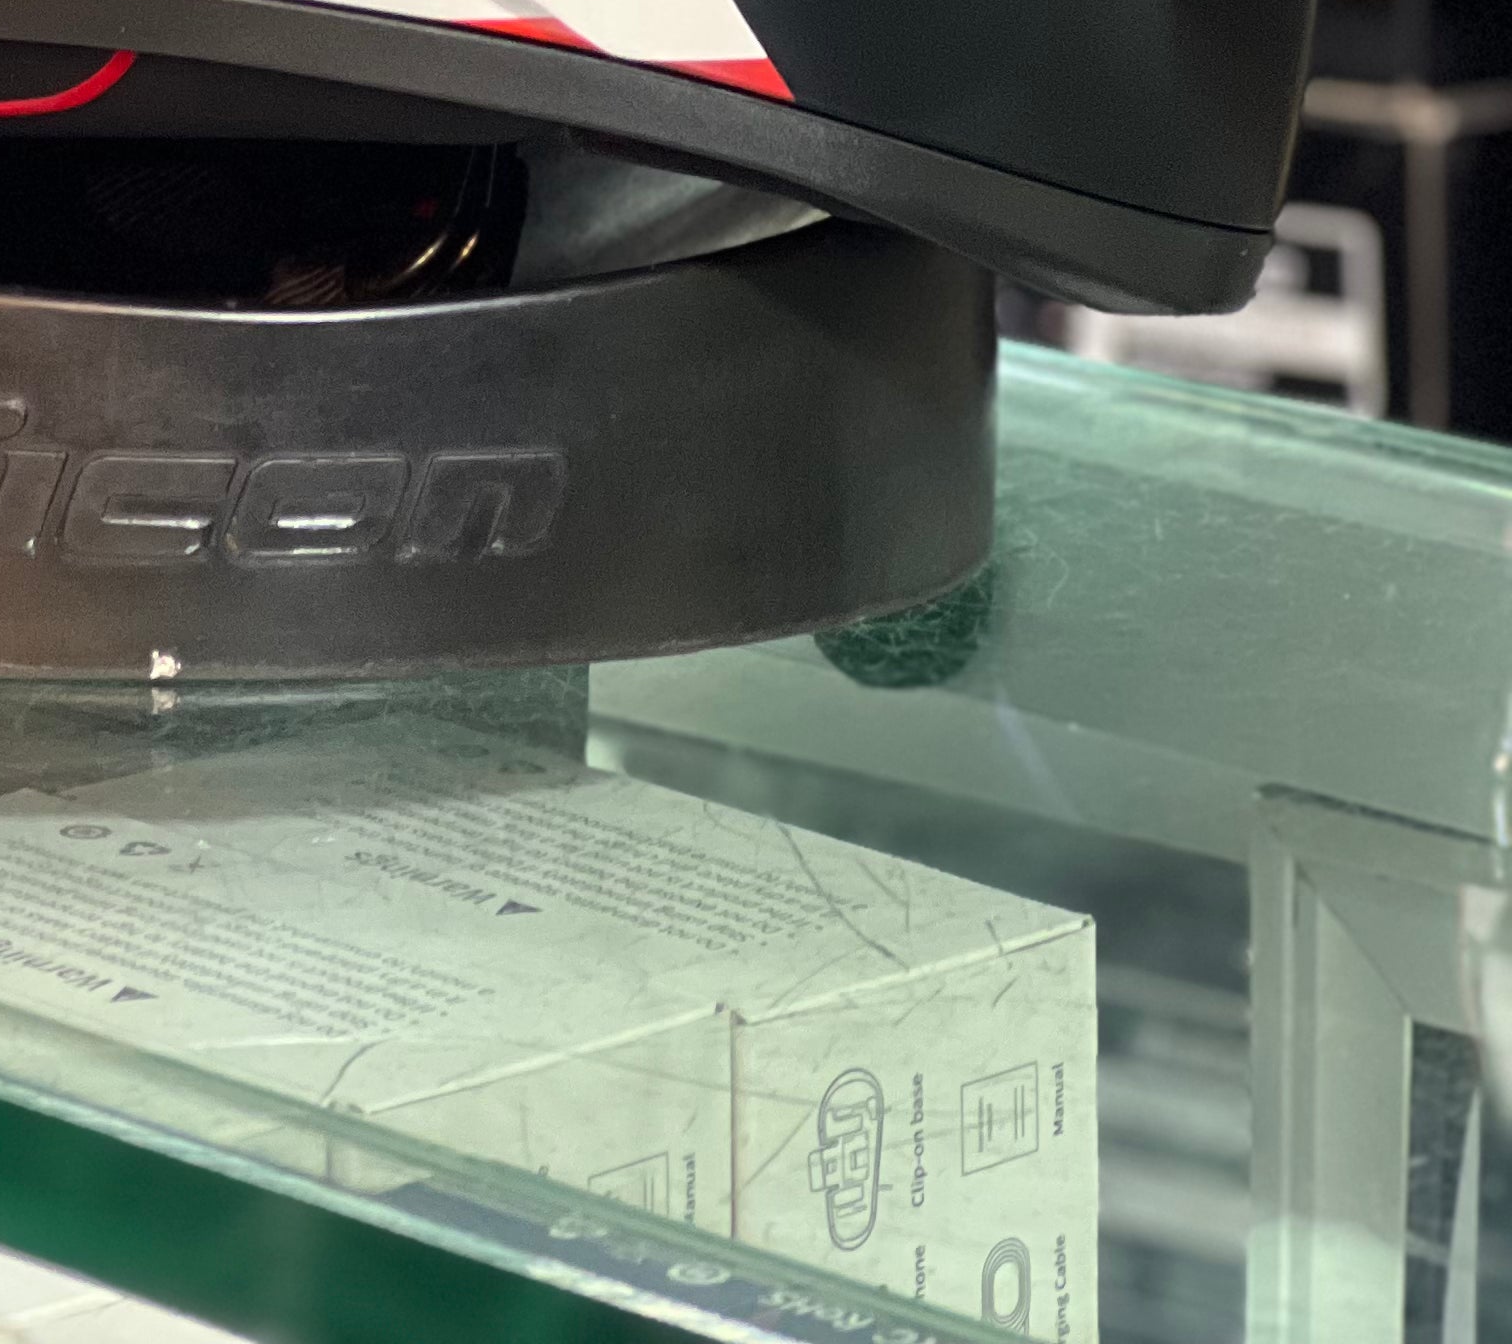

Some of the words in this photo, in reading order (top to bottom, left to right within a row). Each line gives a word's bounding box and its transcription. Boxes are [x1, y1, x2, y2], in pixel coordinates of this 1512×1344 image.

[345, 851, 496, 906] Warnings
[910, 1072, 924, 1126] base
[1052, 1062, 1065, 1136] Manual
[911, 1129, 928, 1208] Clip-on
[1054, 1234, 1066, 1290] Cable
